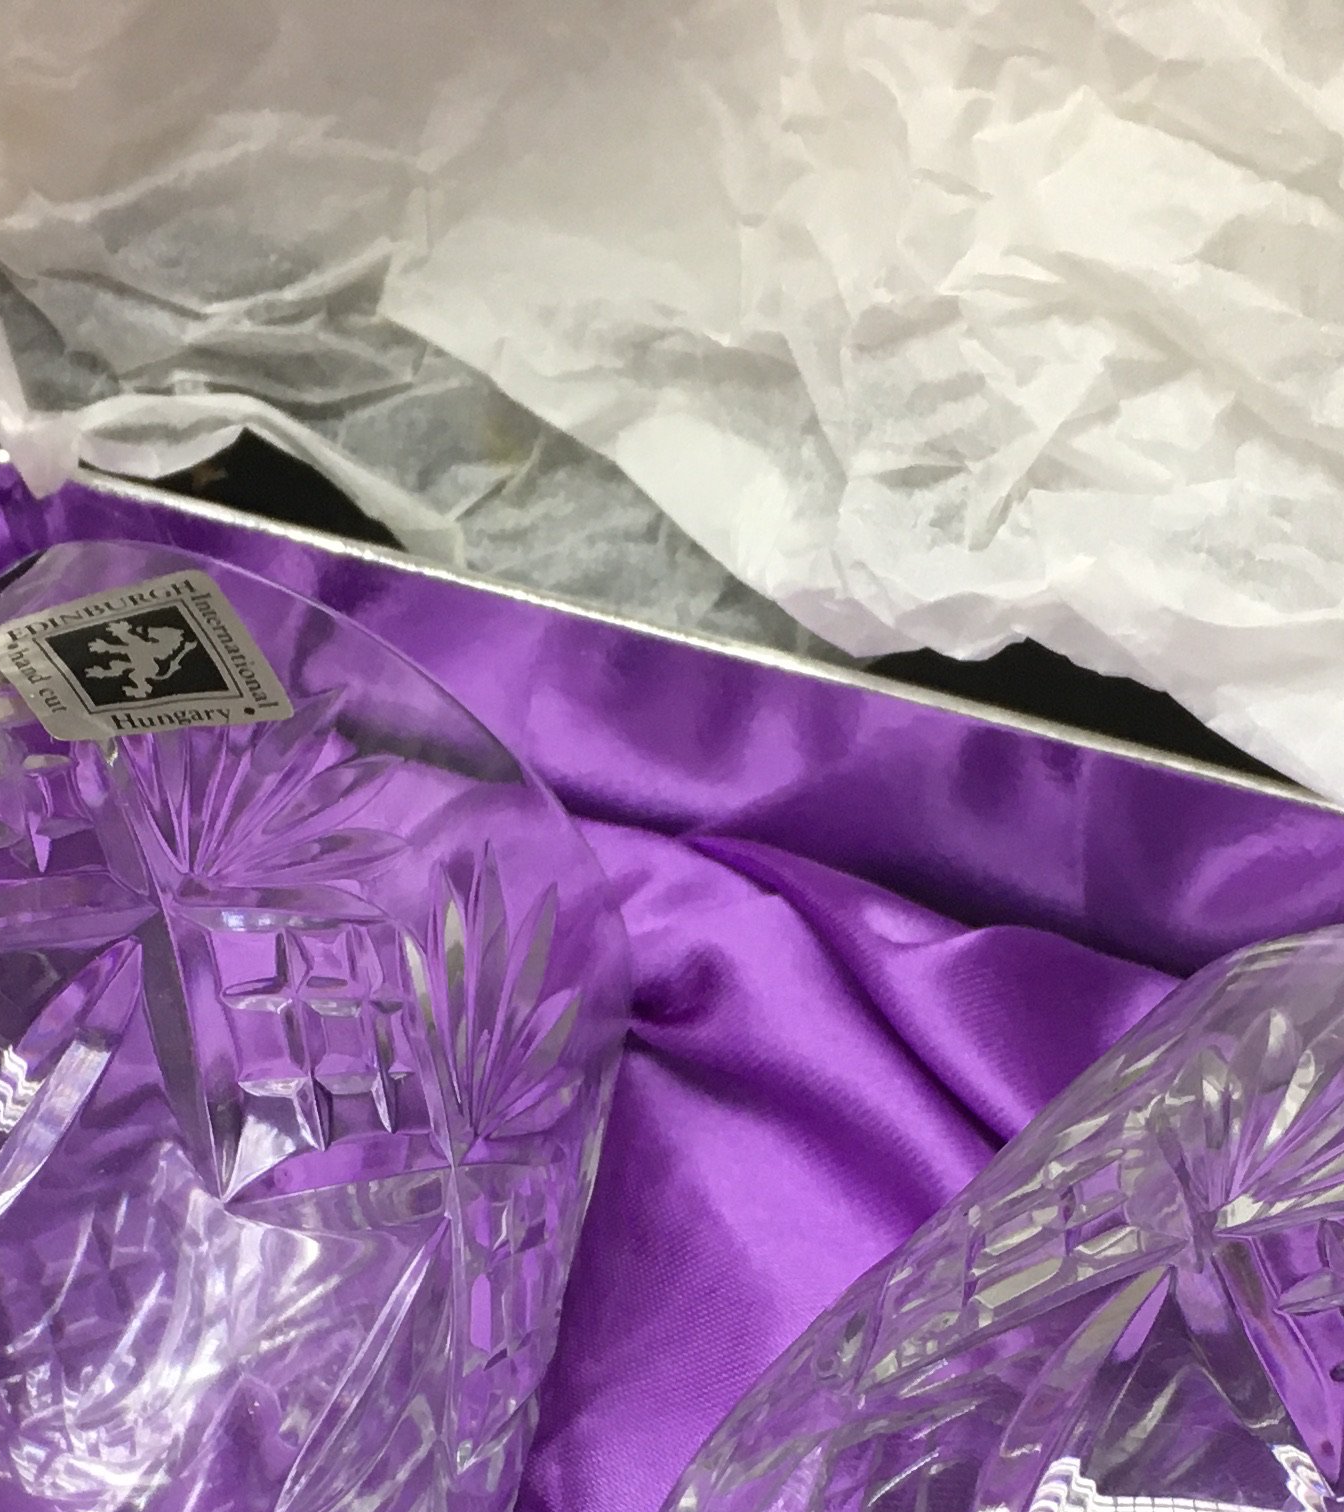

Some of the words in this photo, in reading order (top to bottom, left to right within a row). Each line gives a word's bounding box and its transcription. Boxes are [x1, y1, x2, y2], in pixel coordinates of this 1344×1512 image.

[7, 578, 200, 643] EDINBURGH
[6, 646, 52, 686] hand
[38, 687, 68, 714] cut
[189, 592, 280, 710] International
[110, 706, 231, 731] Hungary
